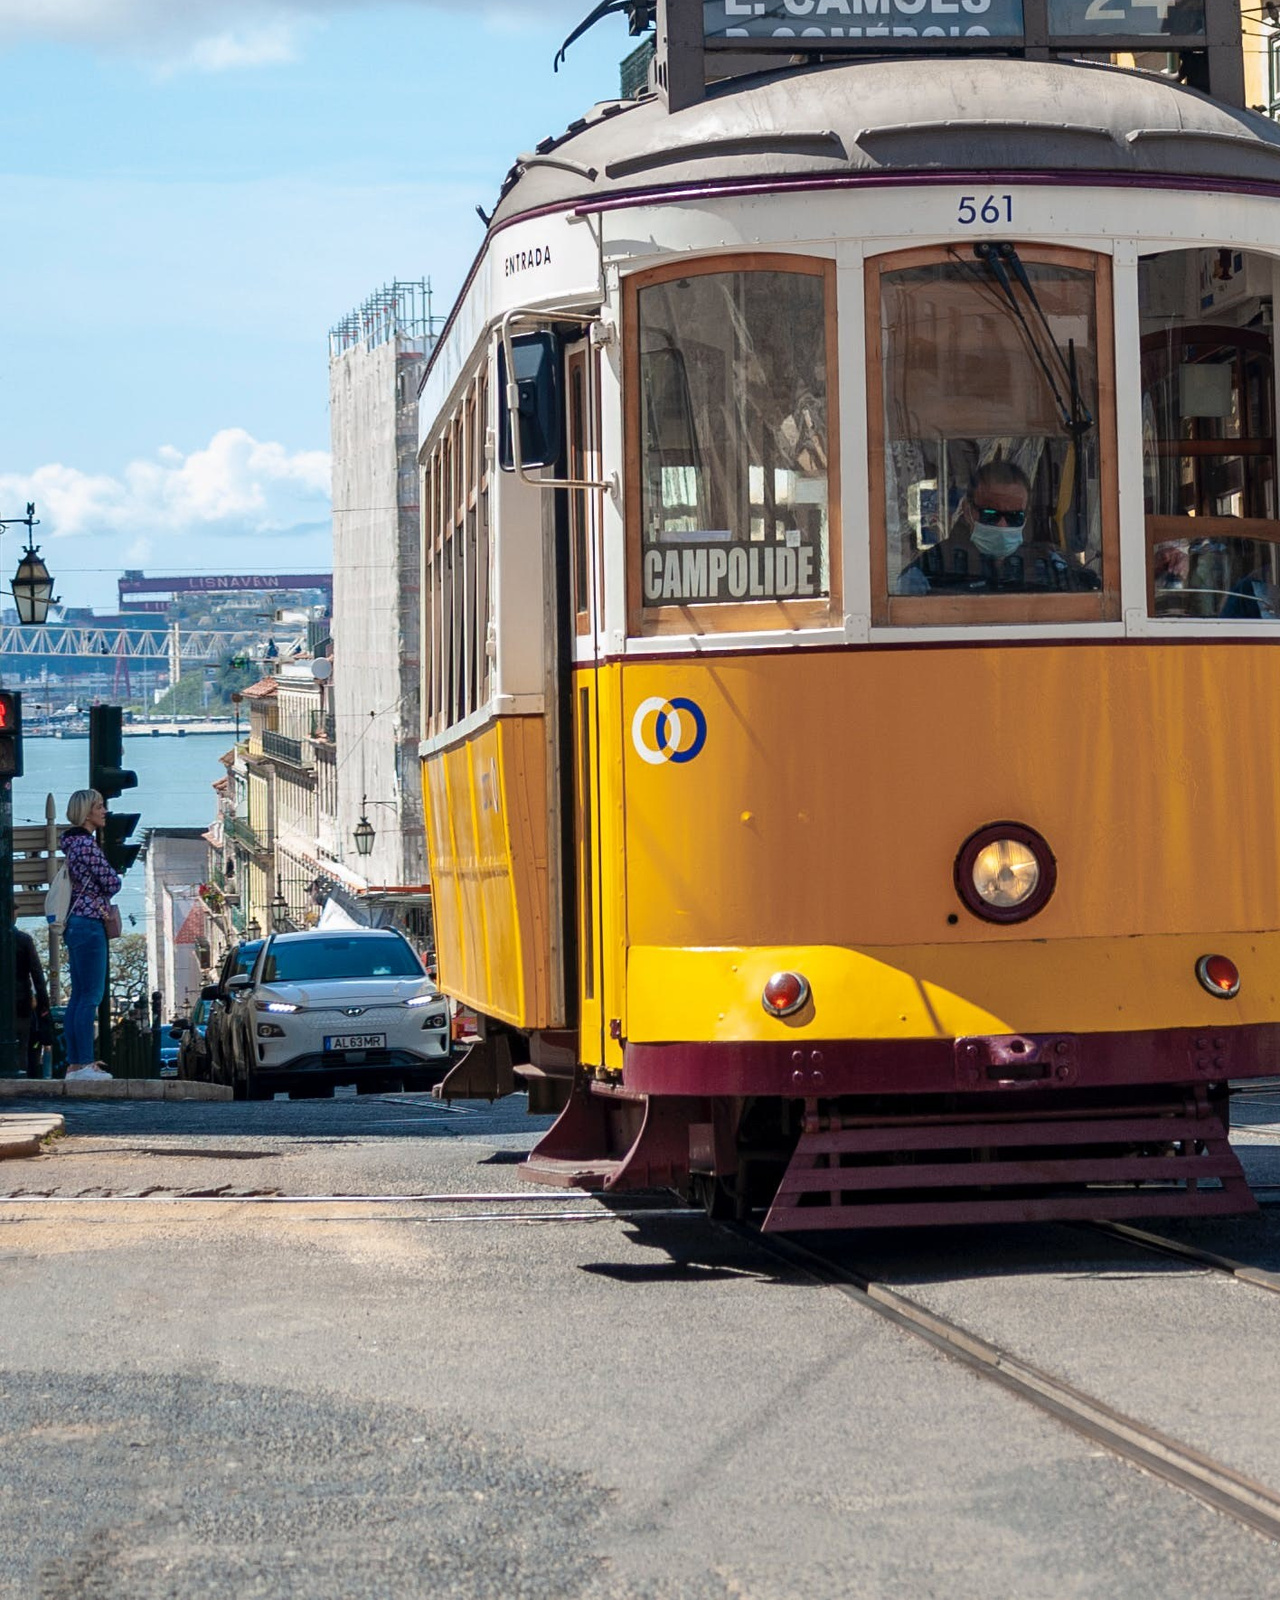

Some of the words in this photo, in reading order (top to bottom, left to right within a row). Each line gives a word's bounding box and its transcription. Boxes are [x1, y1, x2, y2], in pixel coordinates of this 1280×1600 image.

[957, 194, 1012, 224] 561
[505, 245, 551, 277] ENTRADA
[644, 547, 814, 599] CAMPOLIDE
